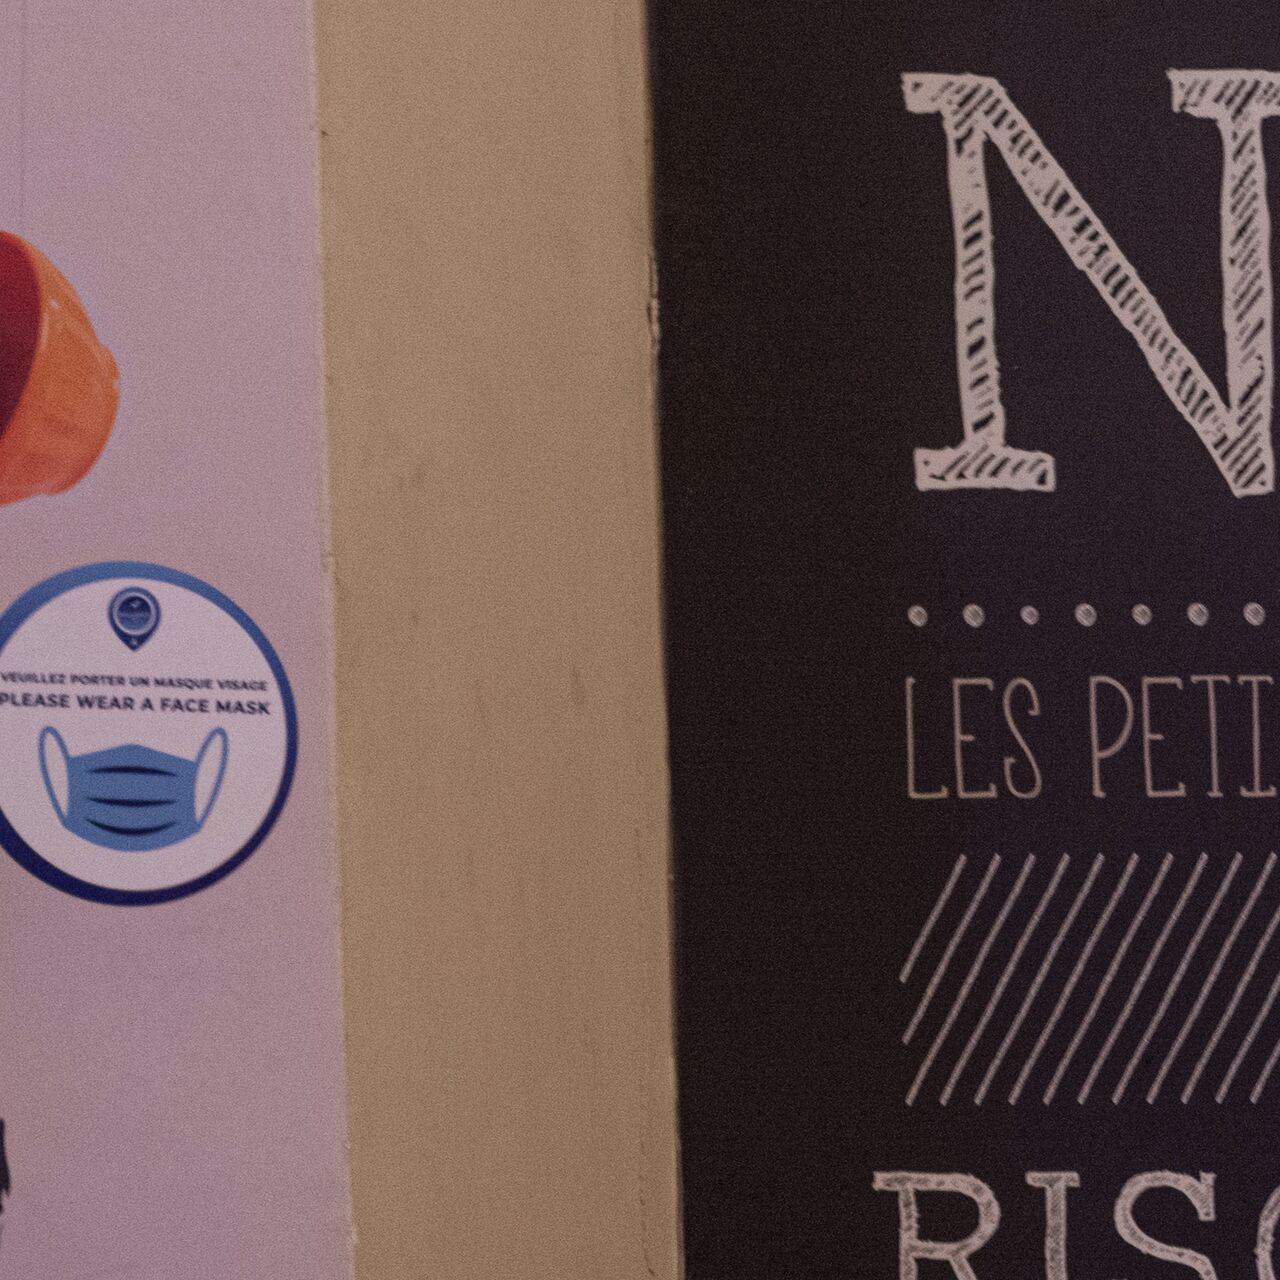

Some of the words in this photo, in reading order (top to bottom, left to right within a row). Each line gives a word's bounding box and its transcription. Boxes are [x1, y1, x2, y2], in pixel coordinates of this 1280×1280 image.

[70, 673, 125, 687] PORTER
[129, 676, 151, 688] UN
[153, 677, 213, 690] MASQUE
[217, 680, 268, 692] VISAGE
[0, 692, 70, 709] PLEASE
[77, 695, 135, 711] WEAR
[141, 698, 155, 712] A
[160, 698, 210, 714] FACE
[215, 701, 271, 716] MASK
[907, 678, 1041, 798] LES
